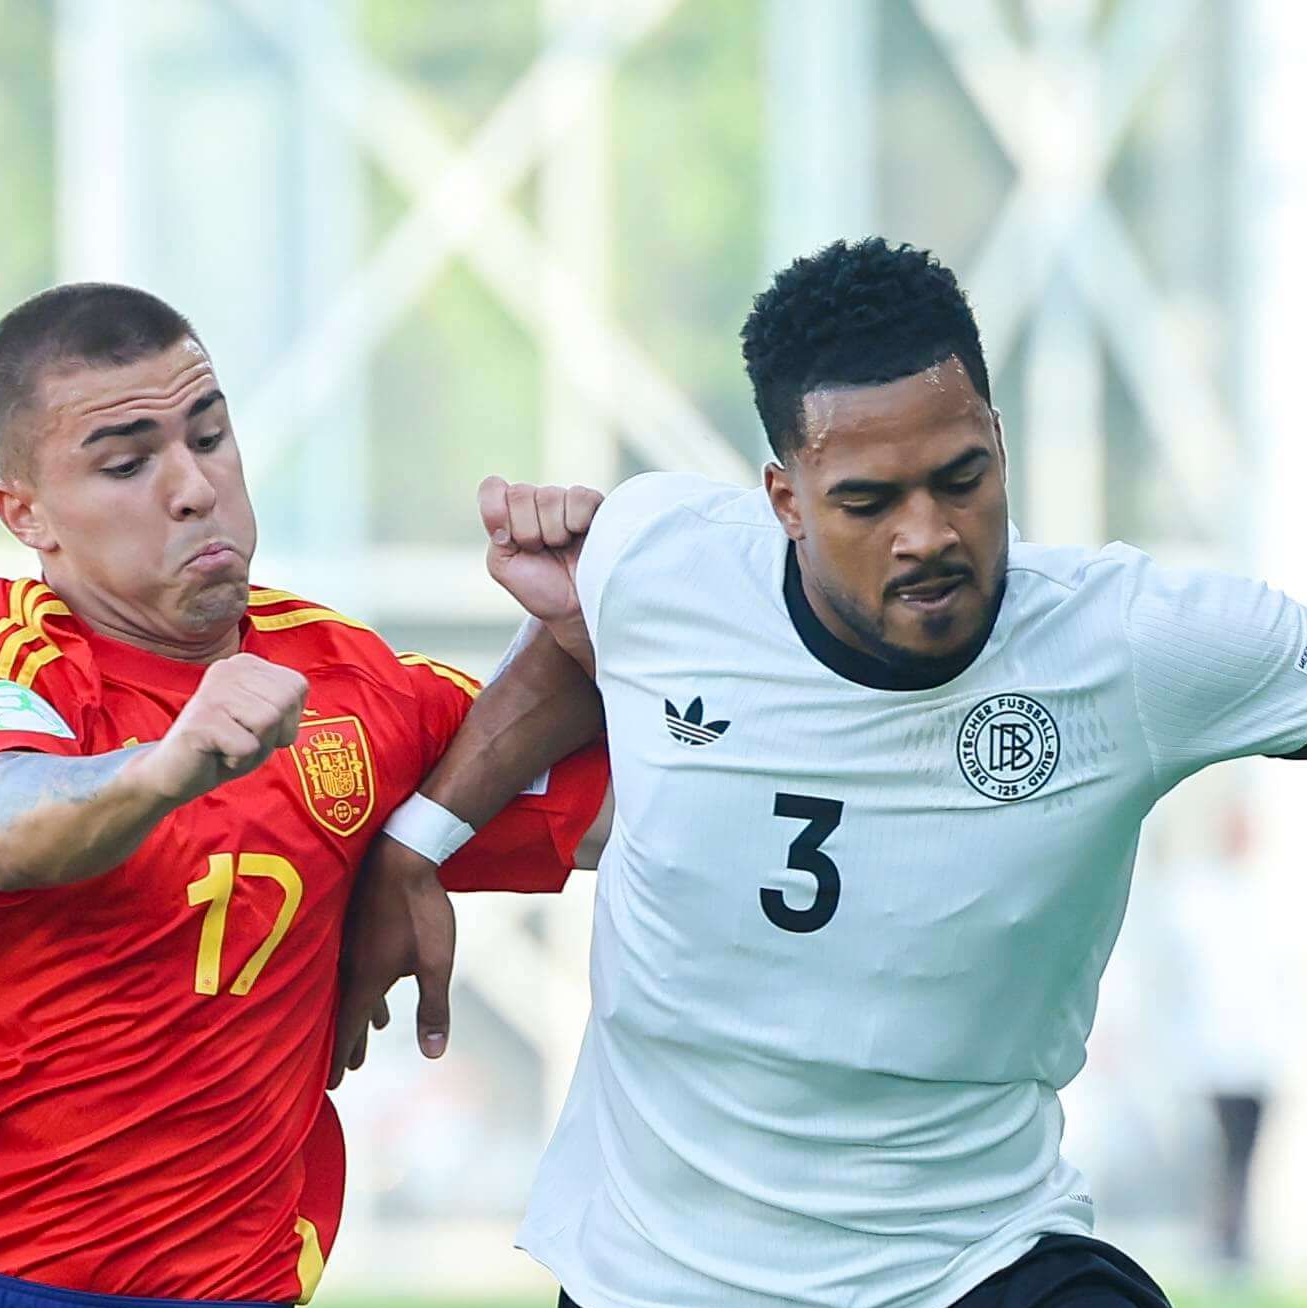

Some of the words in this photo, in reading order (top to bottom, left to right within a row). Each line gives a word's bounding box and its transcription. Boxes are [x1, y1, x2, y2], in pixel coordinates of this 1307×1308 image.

[962, 704, 993, 786] DEUTSCHER
[998, 698, 1055, 786] FUSSBALL-BUND
[186, 852, 304, 996] 17
[759, 792, 845, 934] 3
